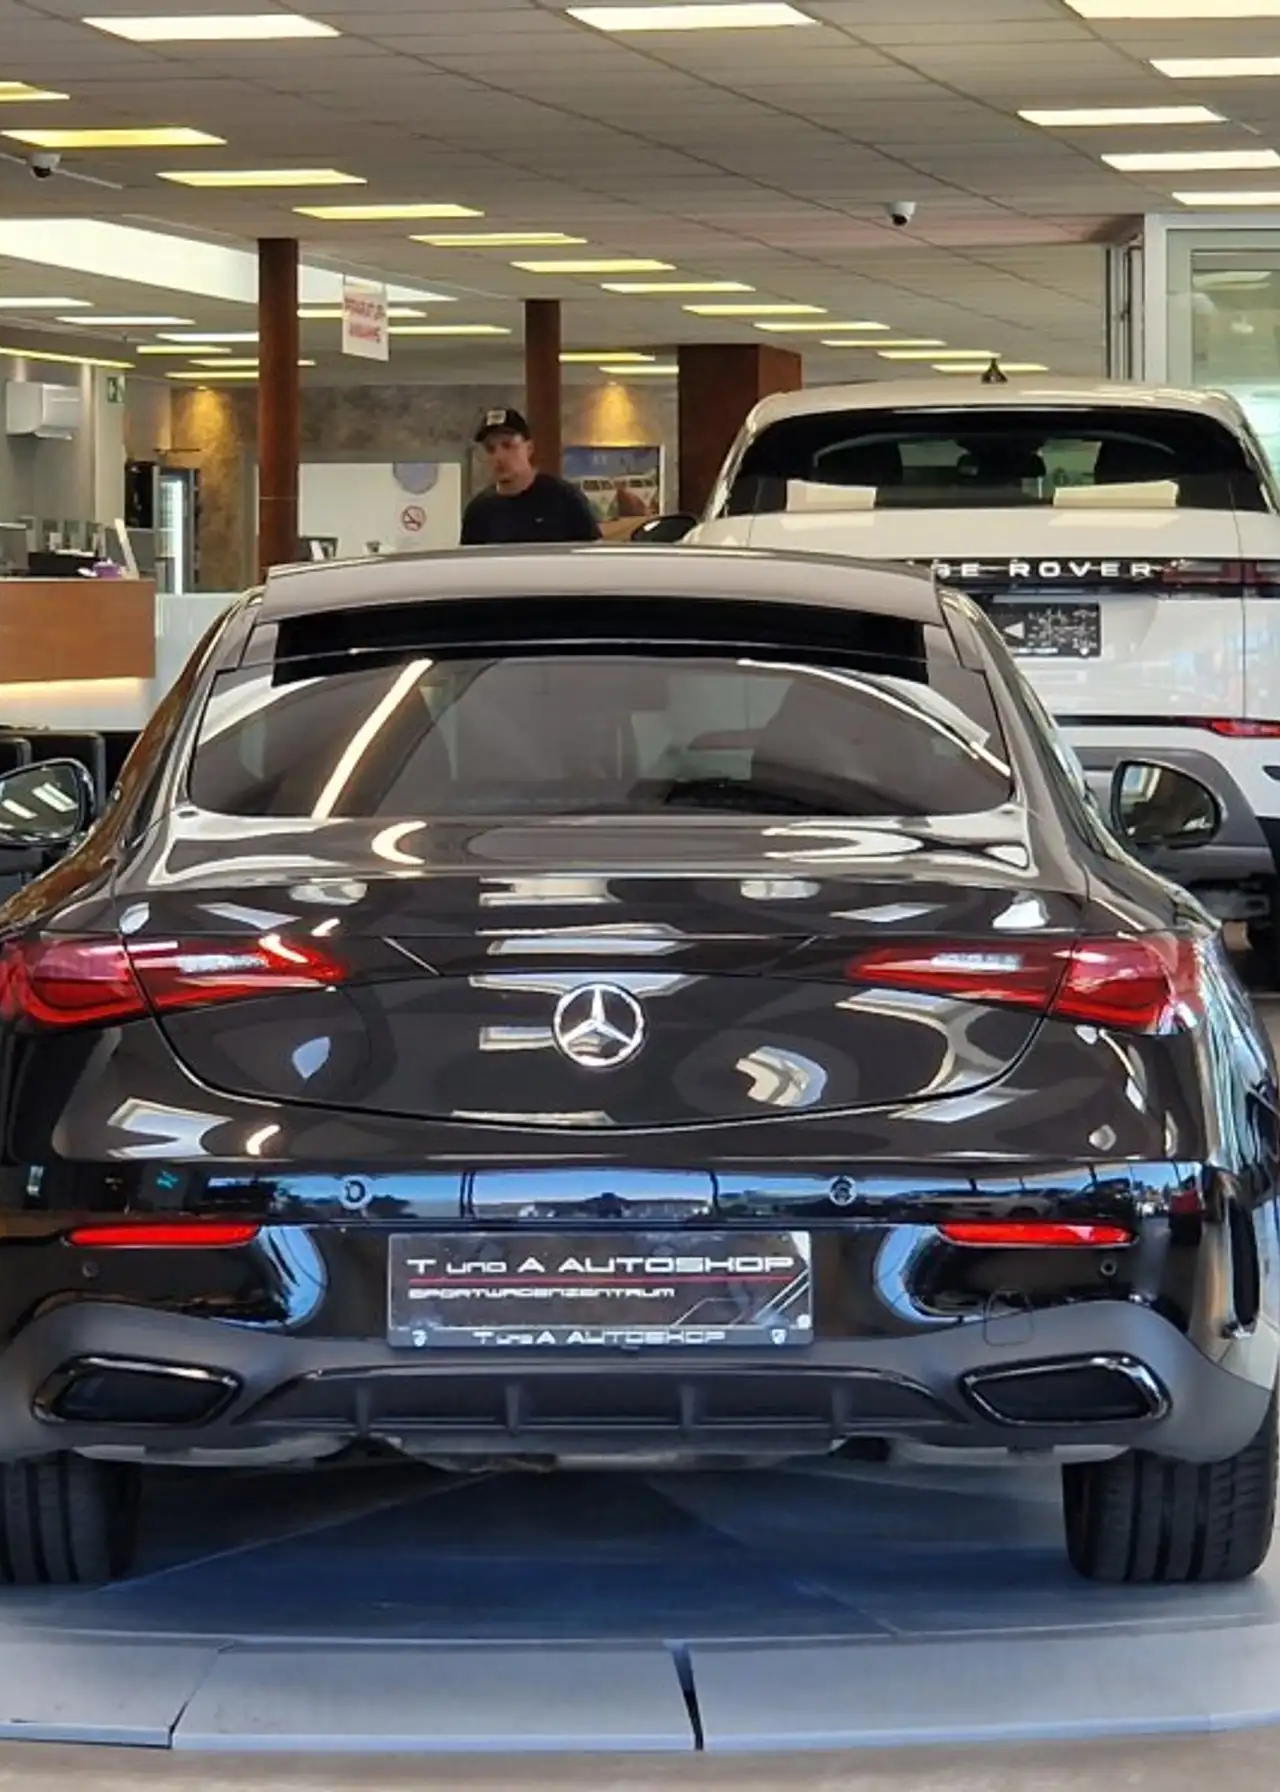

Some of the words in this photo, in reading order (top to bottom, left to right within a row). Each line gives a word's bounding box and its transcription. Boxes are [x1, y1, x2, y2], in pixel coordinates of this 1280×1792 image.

[1009, 561, 1151, 577] ROVER
[407, 1259, 437, 1275] T
[517, 1257, 546, 1273] A
[558, 1256, 795, 1273] AUTOSHOP
[566, 1330, 726, 1345] AUTOSHOP
